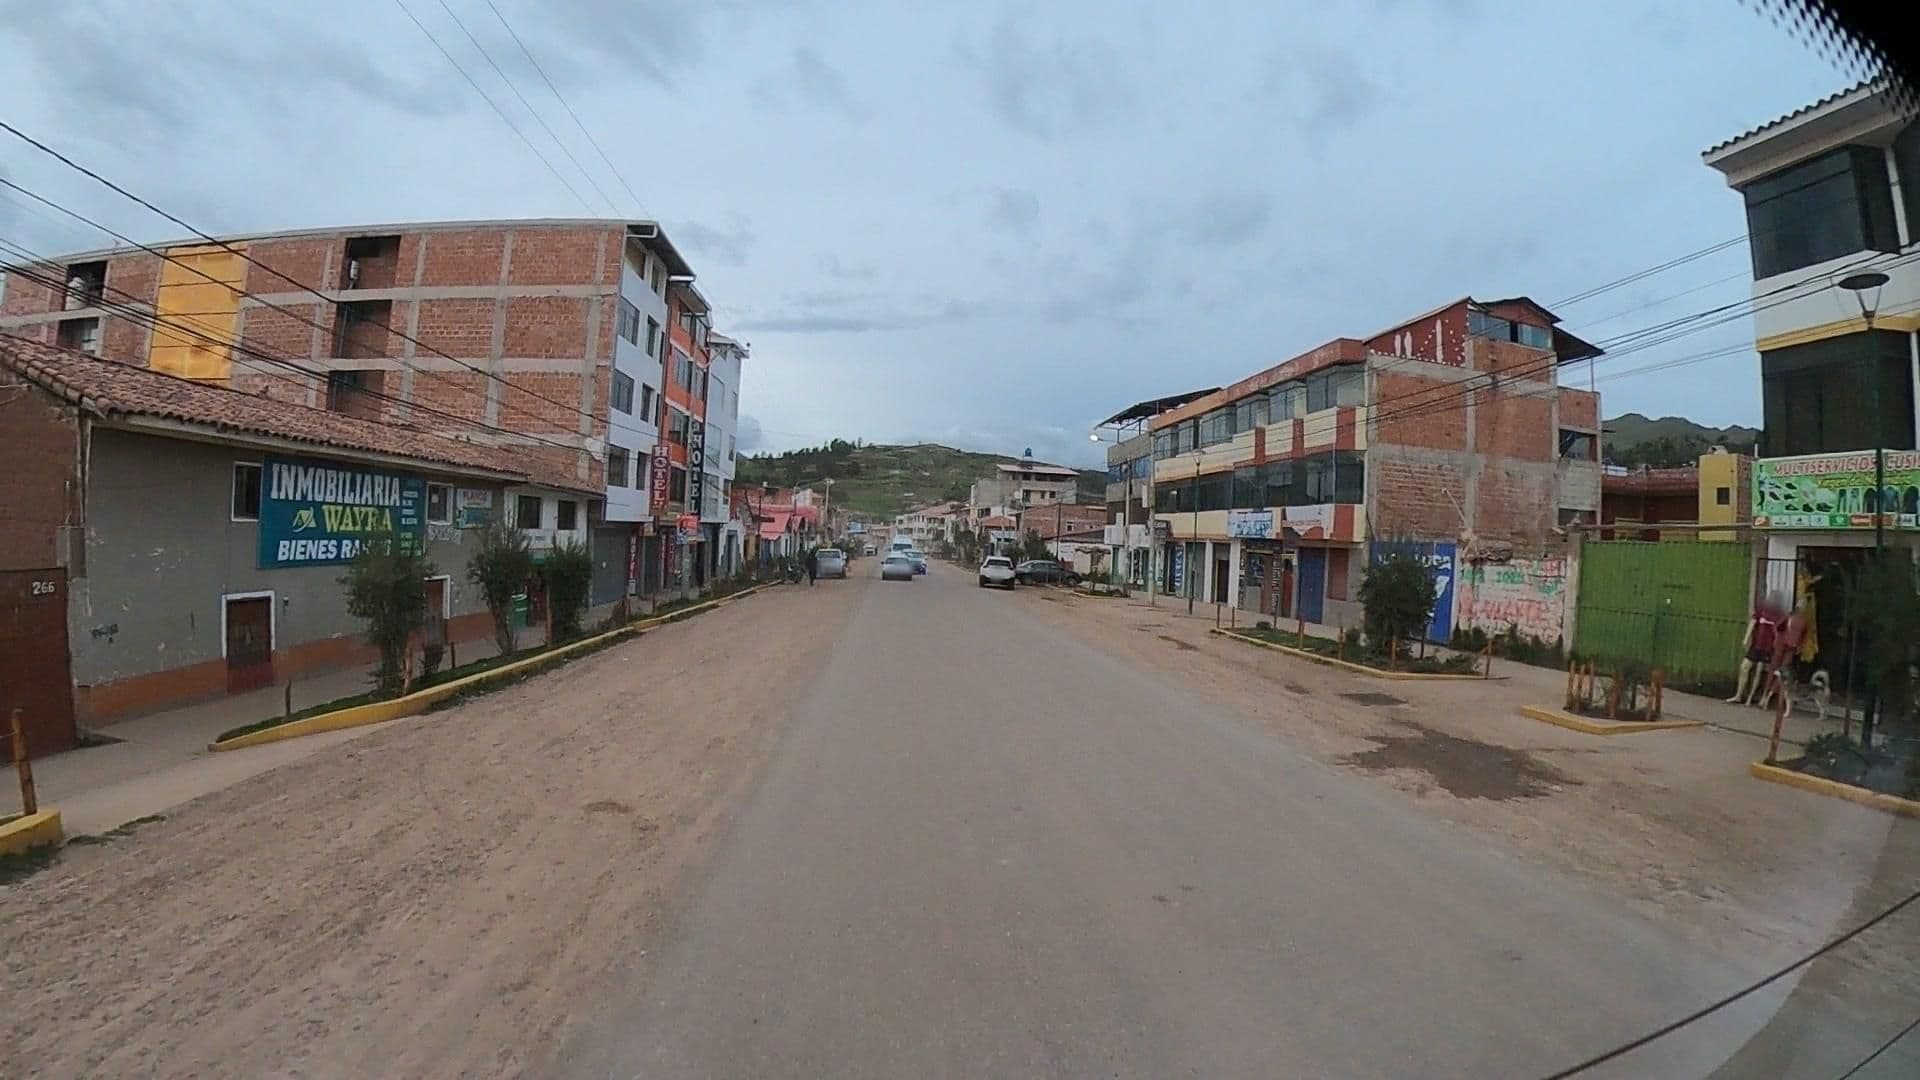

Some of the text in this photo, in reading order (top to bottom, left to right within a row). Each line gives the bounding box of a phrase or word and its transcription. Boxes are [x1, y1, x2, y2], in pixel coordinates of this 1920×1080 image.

[653, 446, 668, 501] HOTEL
[691, 434, 703, 513] HOTEL
[1774, 454, 1877, 476] MULTISERVICIOS
[270, 463, 400, 507] INMOBILIARIA
[322, 504, 392, 533] WAYRA
[277, 540, 337, 561] BIENES
[31, 581, 55, 595] 266
